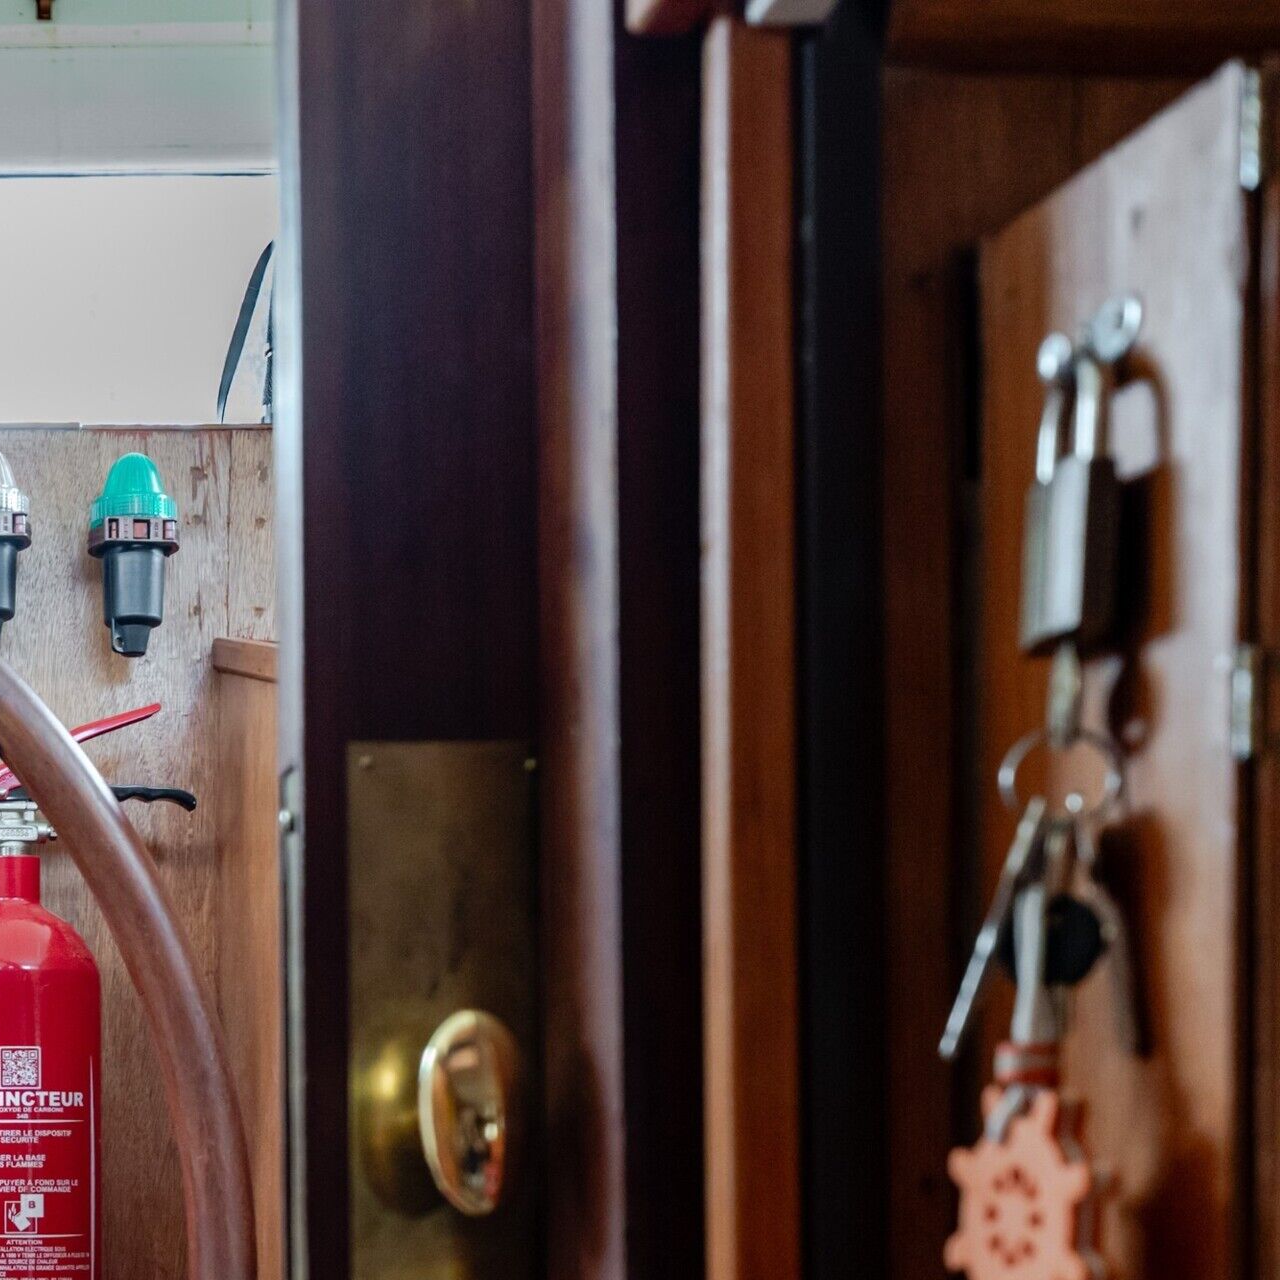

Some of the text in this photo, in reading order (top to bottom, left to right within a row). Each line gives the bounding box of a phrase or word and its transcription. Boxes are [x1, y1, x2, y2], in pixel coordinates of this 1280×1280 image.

[22, 1129, 33, 1137] LE
[34, 1129, 72, 1137] DISPOSITIF
[0, 1136, 39, 1144] SECURITE
[13, 1154, 24, 1162] LA
[25, 1154, 46, 1162] BASE
[71, 1179, 78, 1187] LE
[28, 1200, 36, 1209] B
